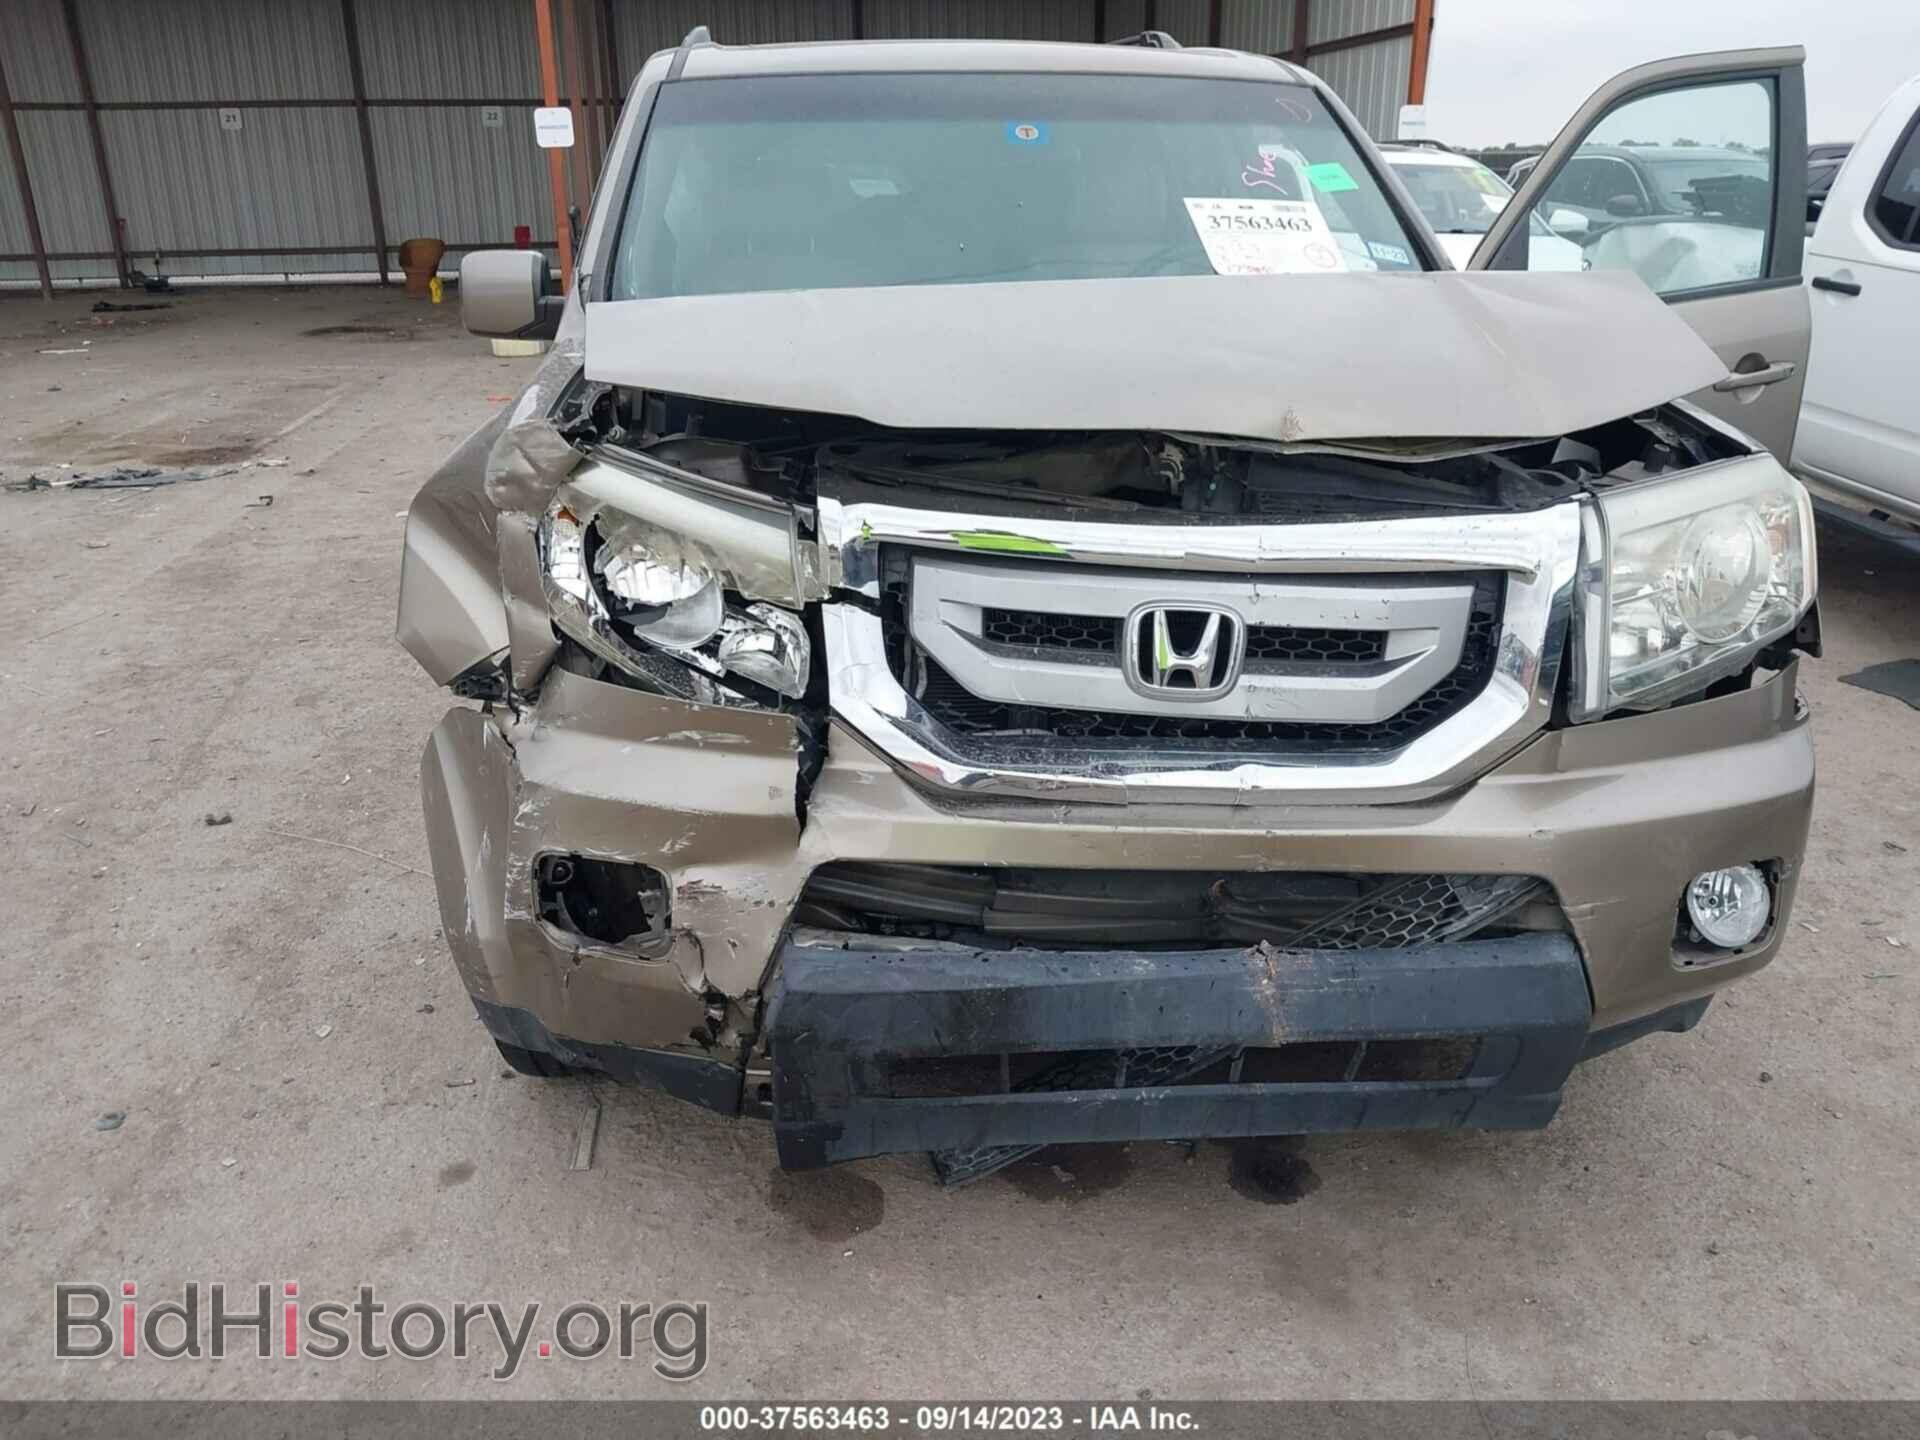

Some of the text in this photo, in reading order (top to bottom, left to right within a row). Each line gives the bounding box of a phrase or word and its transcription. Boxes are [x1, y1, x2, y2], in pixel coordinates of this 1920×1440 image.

[224, 113, 237, 123] 21
[486, 111, 498, 121] 22
[1208, 214, 1313, 232] 37563463
